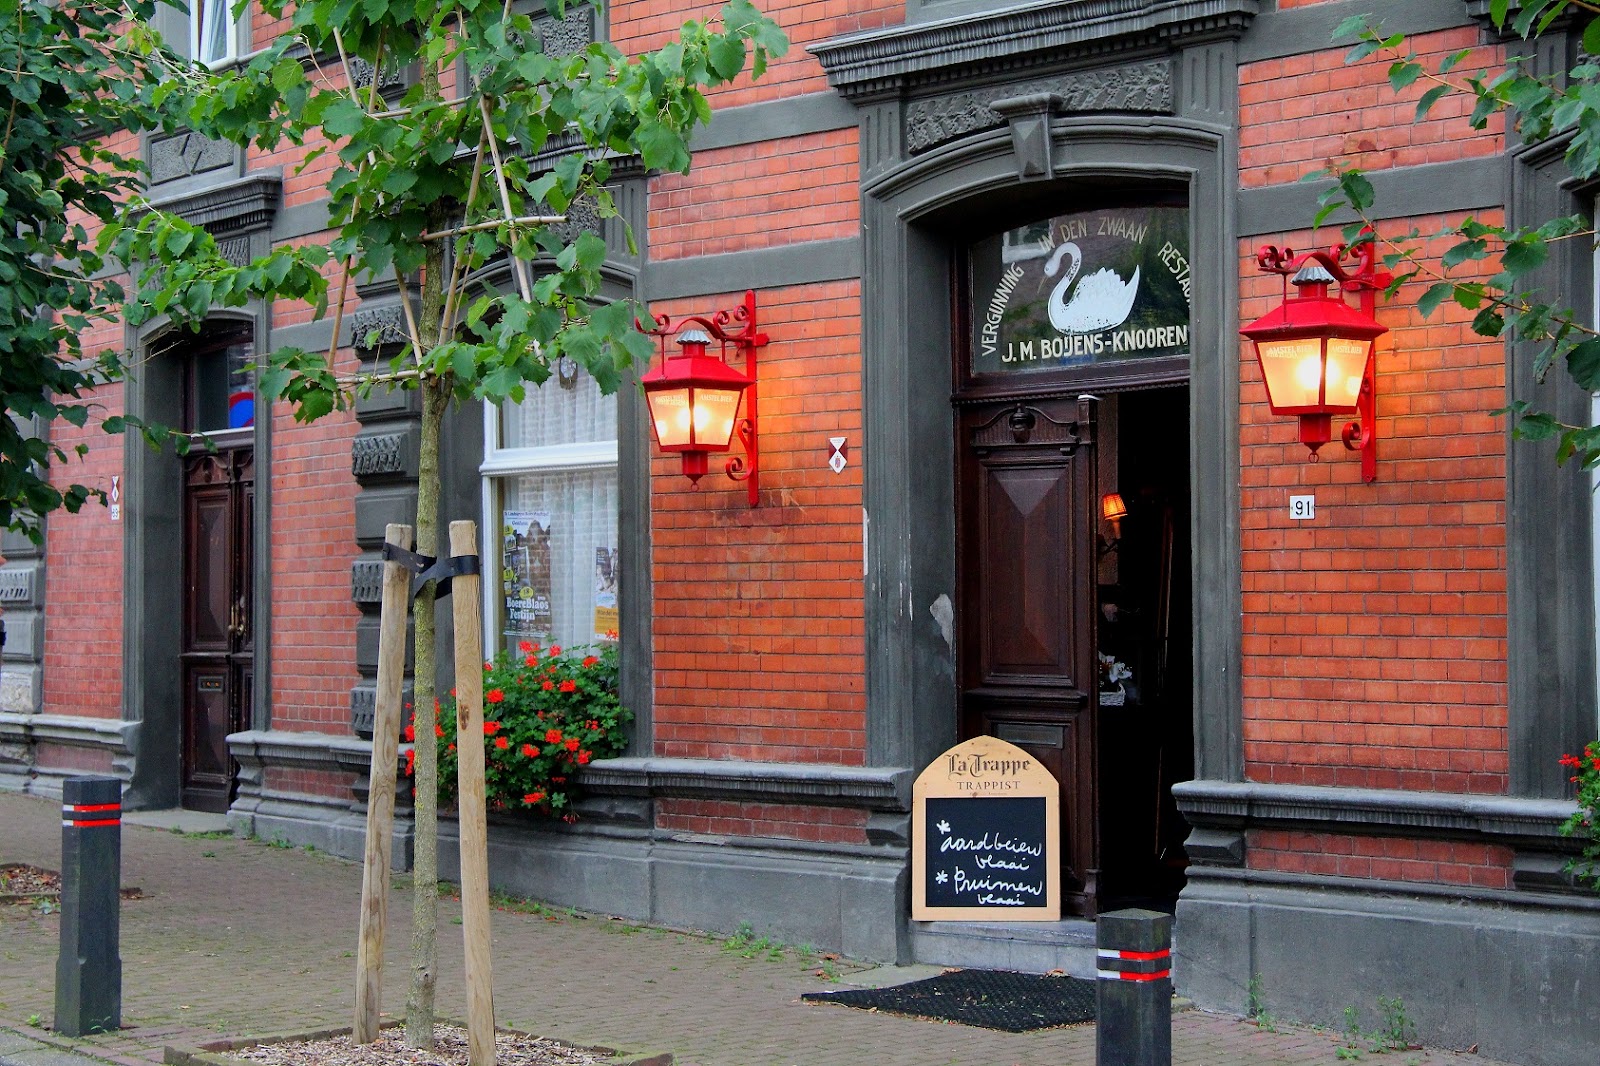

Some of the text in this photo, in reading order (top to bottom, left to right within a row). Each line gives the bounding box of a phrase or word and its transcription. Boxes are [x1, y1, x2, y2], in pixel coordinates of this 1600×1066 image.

[1059, 218, 1087, 243] DEN
[1097, 216, 1148, 244] ZWAAN
[1157, 240, 1190, 310] RESTAU
[981, 261, 1025, 357] VERGUNNING
[1295, 500, 1310, 516] 91
[944, 752, 1031, 781] La Trappe
[956, 780, 1021, 791] TRAPPIST
